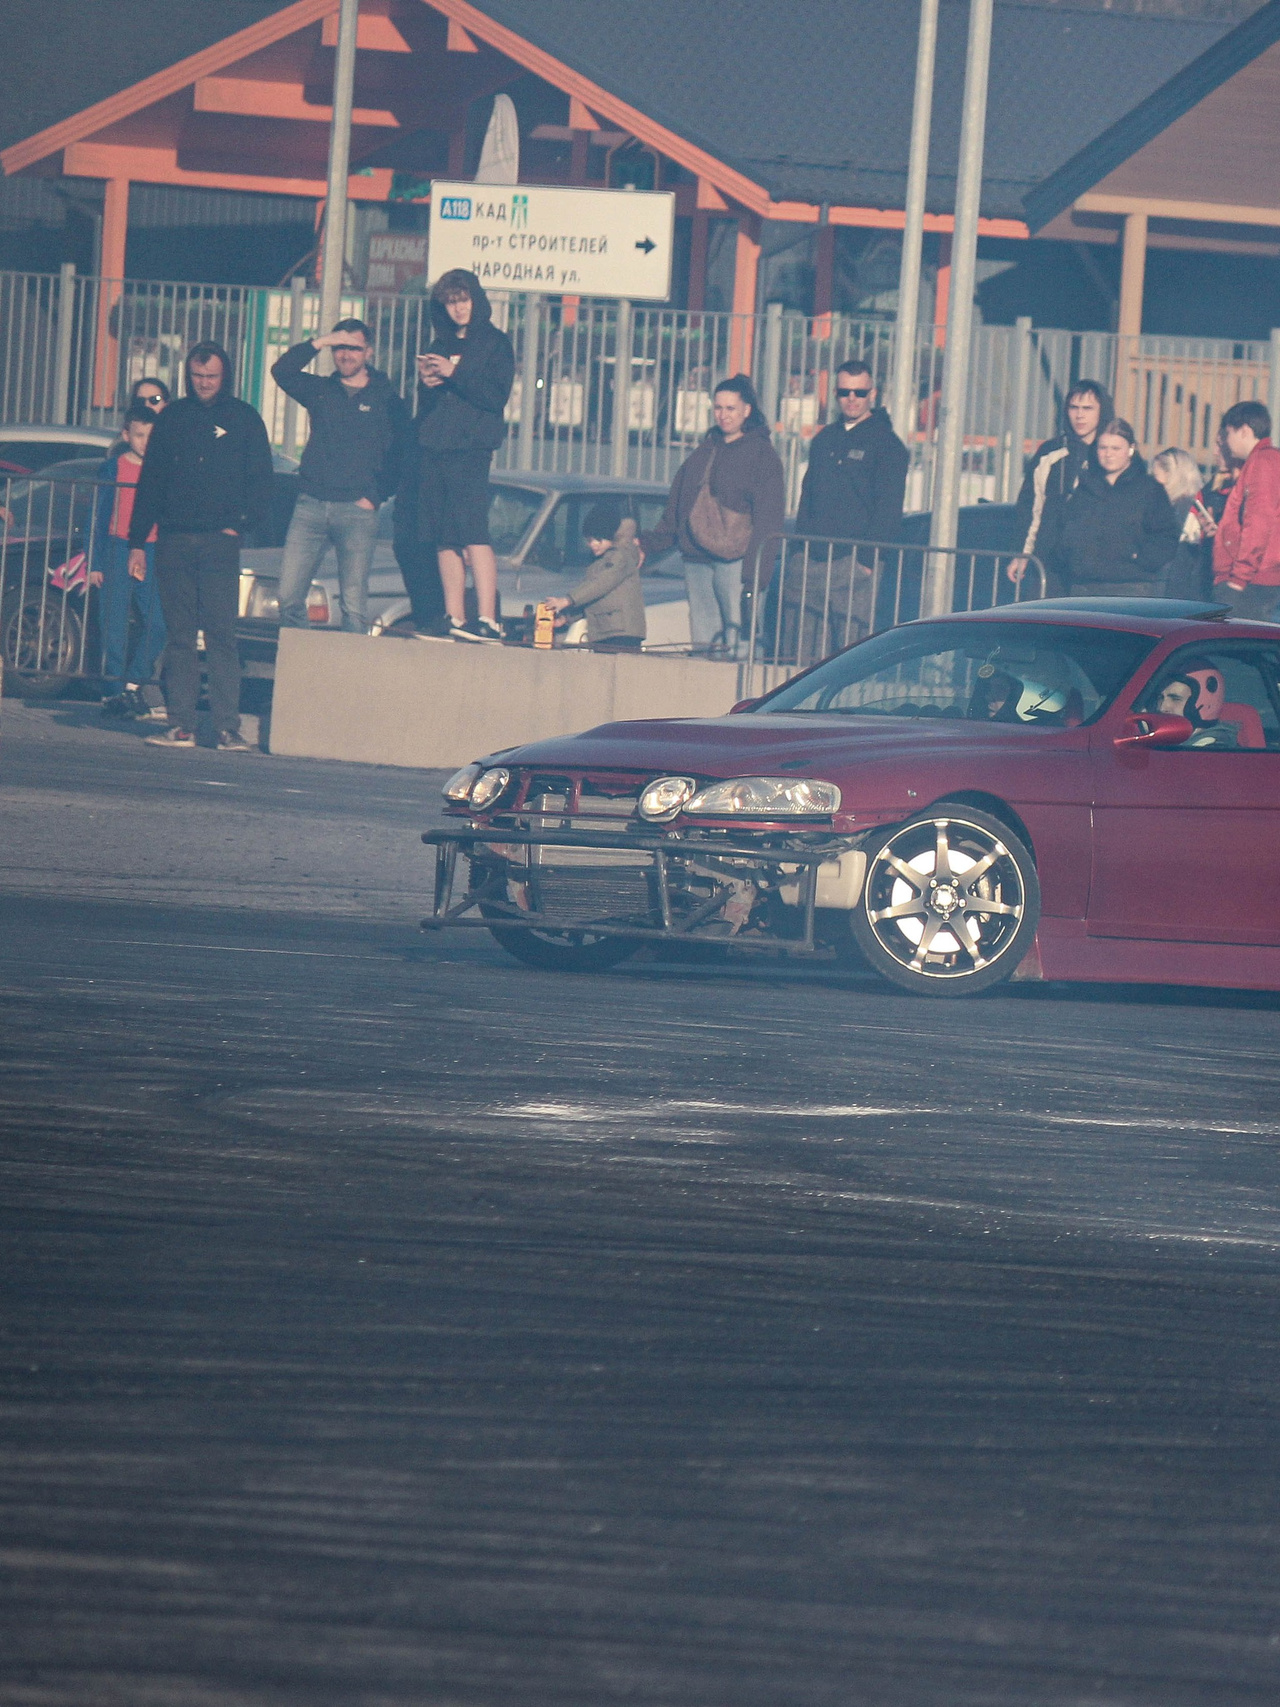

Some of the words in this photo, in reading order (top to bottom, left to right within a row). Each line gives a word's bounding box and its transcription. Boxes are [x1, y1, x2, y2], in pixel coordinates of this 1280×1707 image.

[442, 199, 470, 219] А118
[475, 203, 507, 221] КАД
[473, 235, 501, 252] пр-т
[509, 234, 608, 254] СТРОИТЕЛЕЙ
[472, 261, 555, 281] НАРОДНАЯ
[561, 270, 581, 287] ул.
